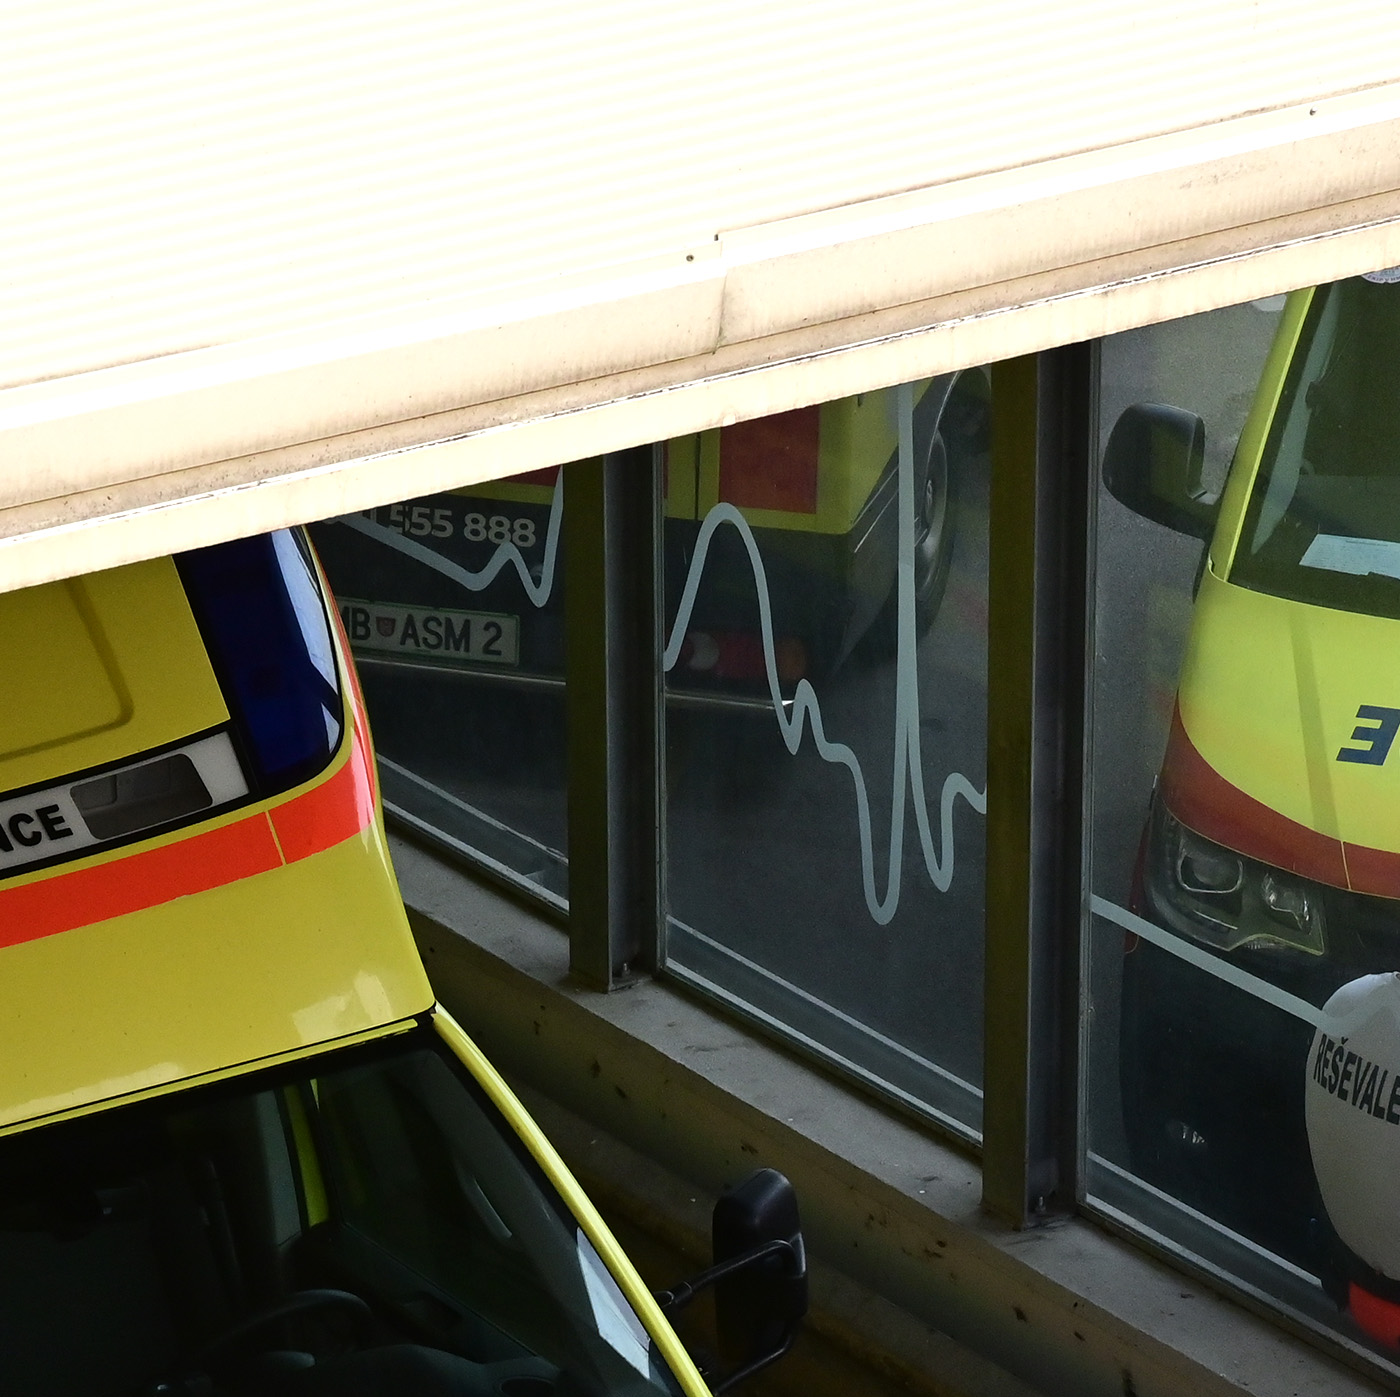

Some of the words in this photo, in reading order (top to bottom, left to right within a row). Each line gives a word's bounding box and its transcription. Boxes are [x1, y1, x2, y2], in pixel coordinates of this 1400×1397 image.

[464, 512, 537, 548] 888
[400, 613, 471, 653] ASM
[483, 621, 503, 656] 2
